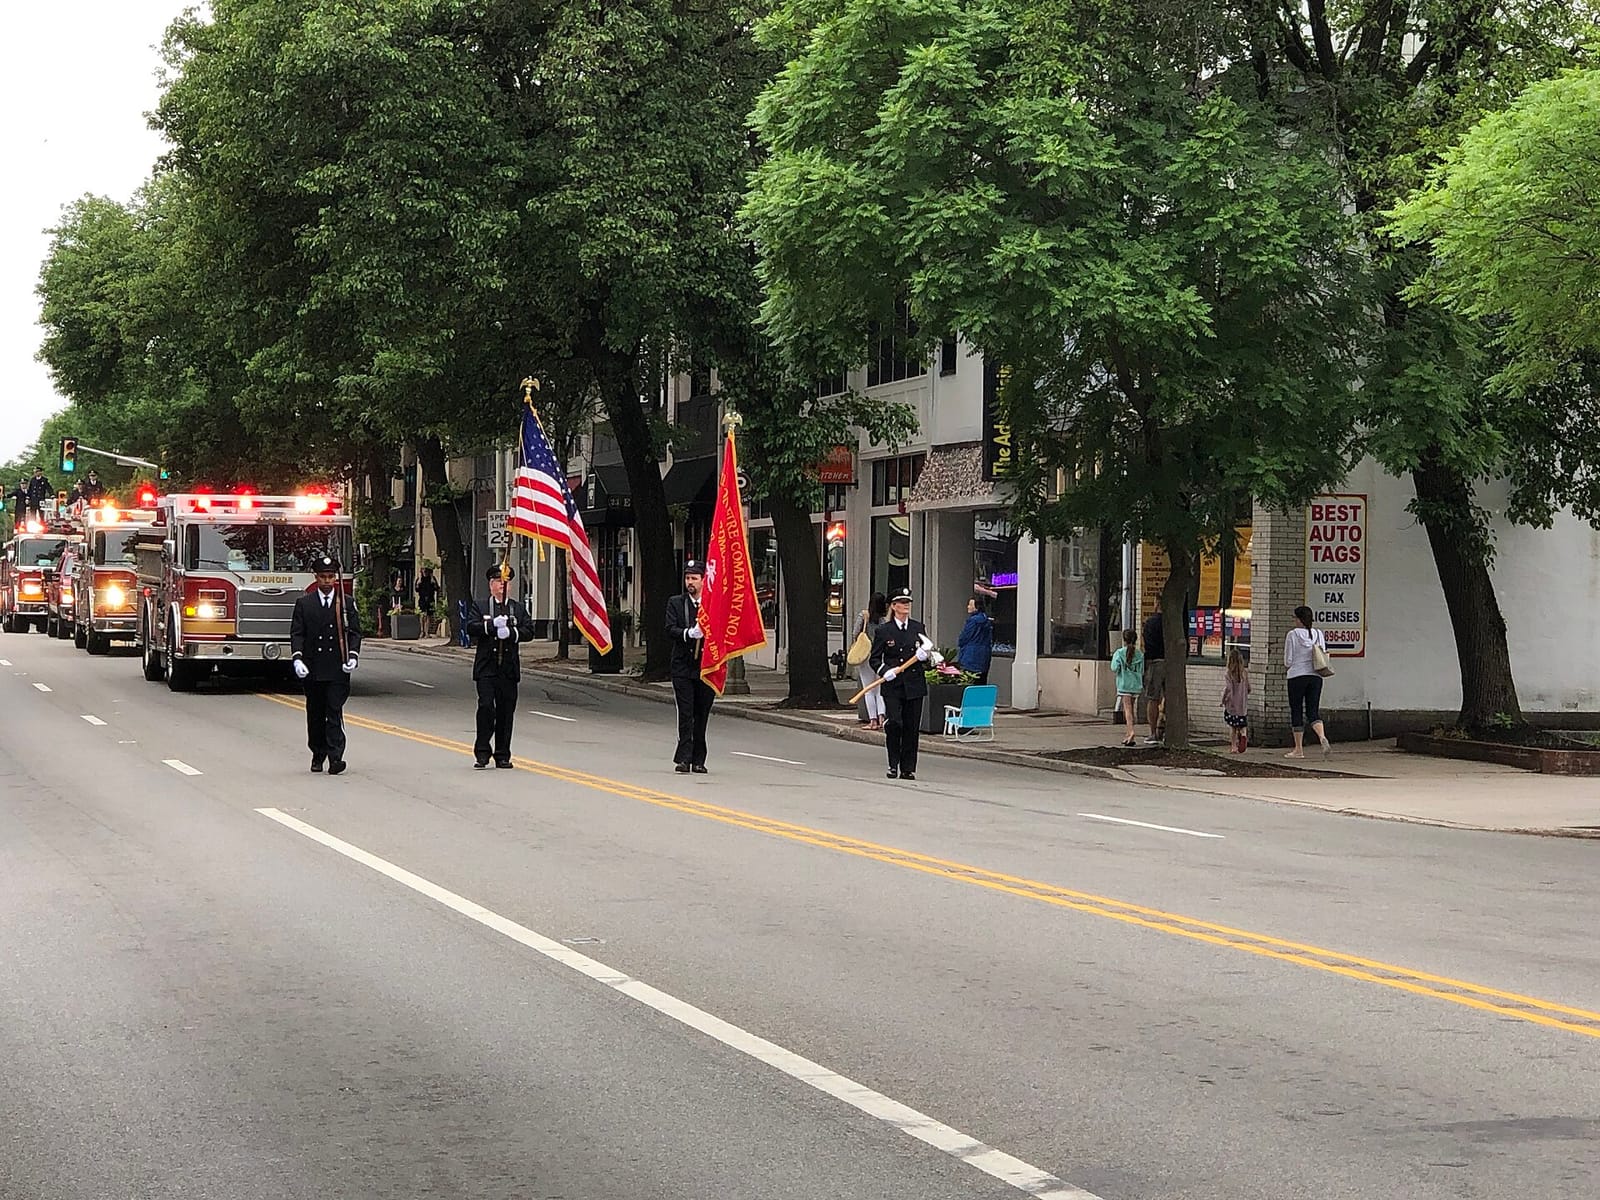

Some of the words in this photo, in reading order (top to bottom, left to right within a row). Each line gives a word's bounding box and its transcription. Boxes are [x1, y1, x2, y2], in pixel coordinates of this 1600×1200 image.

[1312, 505, 1361, 521] BEST
[490, 530, 514, 544] 25
[1309, 525, 1362, 542] AUTO
[1311, 546, 1361, 562] TAGS
[250, 576, 293, 584] ARDMORE
[731, 541, 745, 612] COMPANY
[1313, 573, 1355, 584] NOTARY
[1324, 592, 1344, 604] FAX
[725, 613, 741, 638] NO.
[1325, 631, 1360, 642] 896-6300
